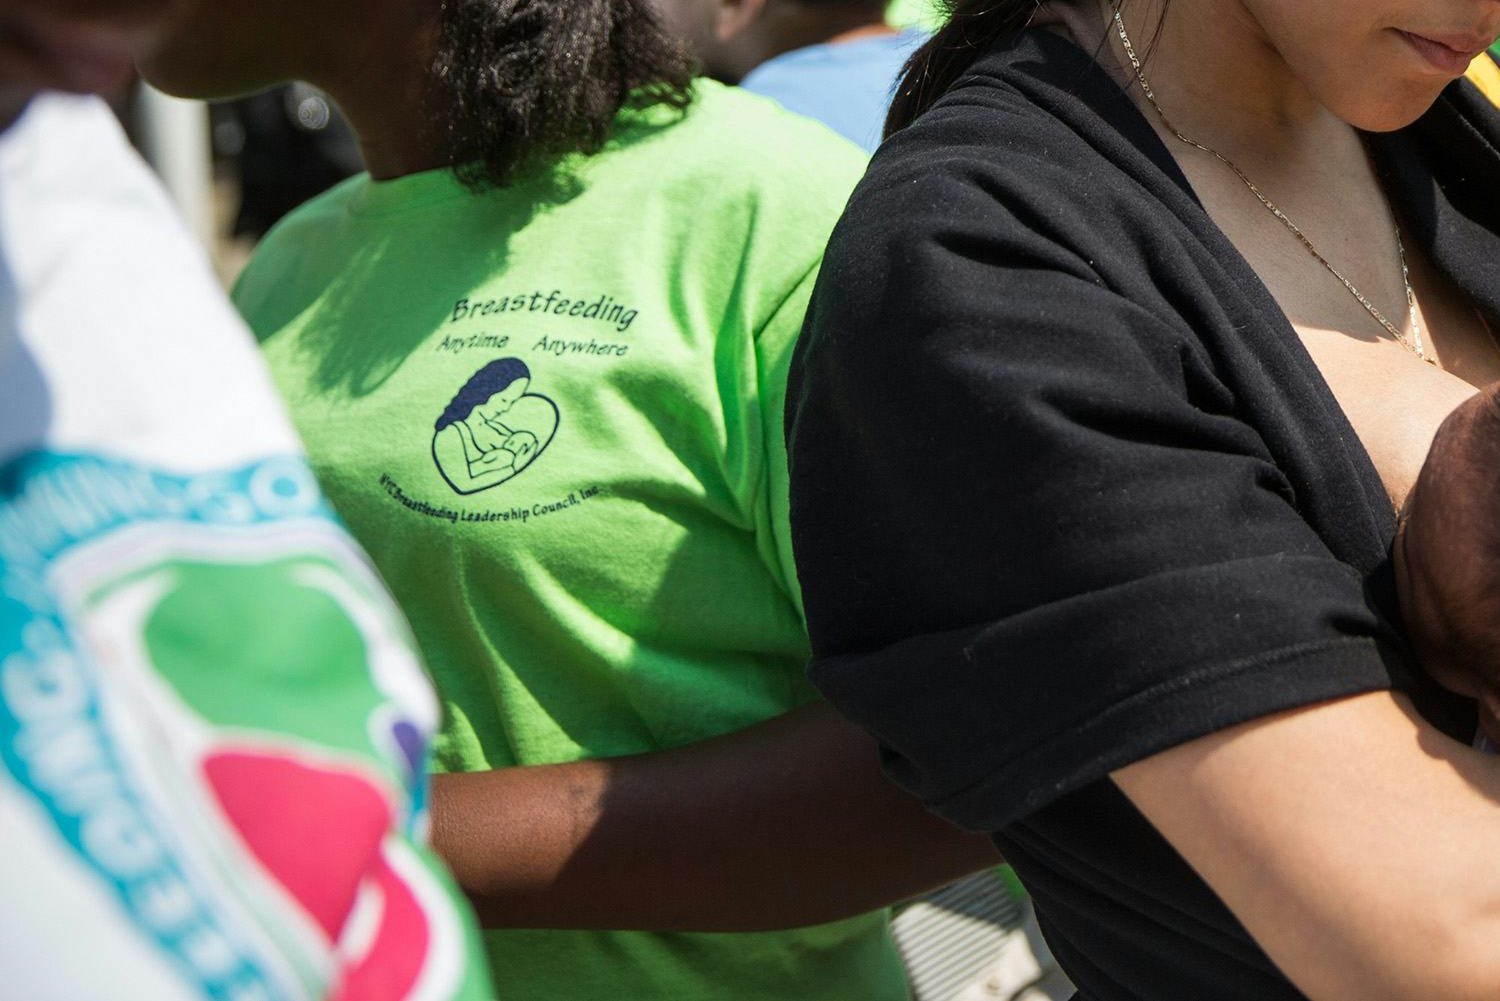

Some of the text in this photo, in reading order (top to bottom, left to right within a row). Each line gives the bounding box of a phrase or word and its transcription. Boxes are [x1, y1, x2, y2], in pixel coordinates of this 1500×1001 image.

[451, 290, 638, 332] Breastfeeding
[437, 331, 628, 356] Anytime Anywhere
[394, 487, 459, 524] Breastfeeding
[461, 508, 530, 523] Leadership
